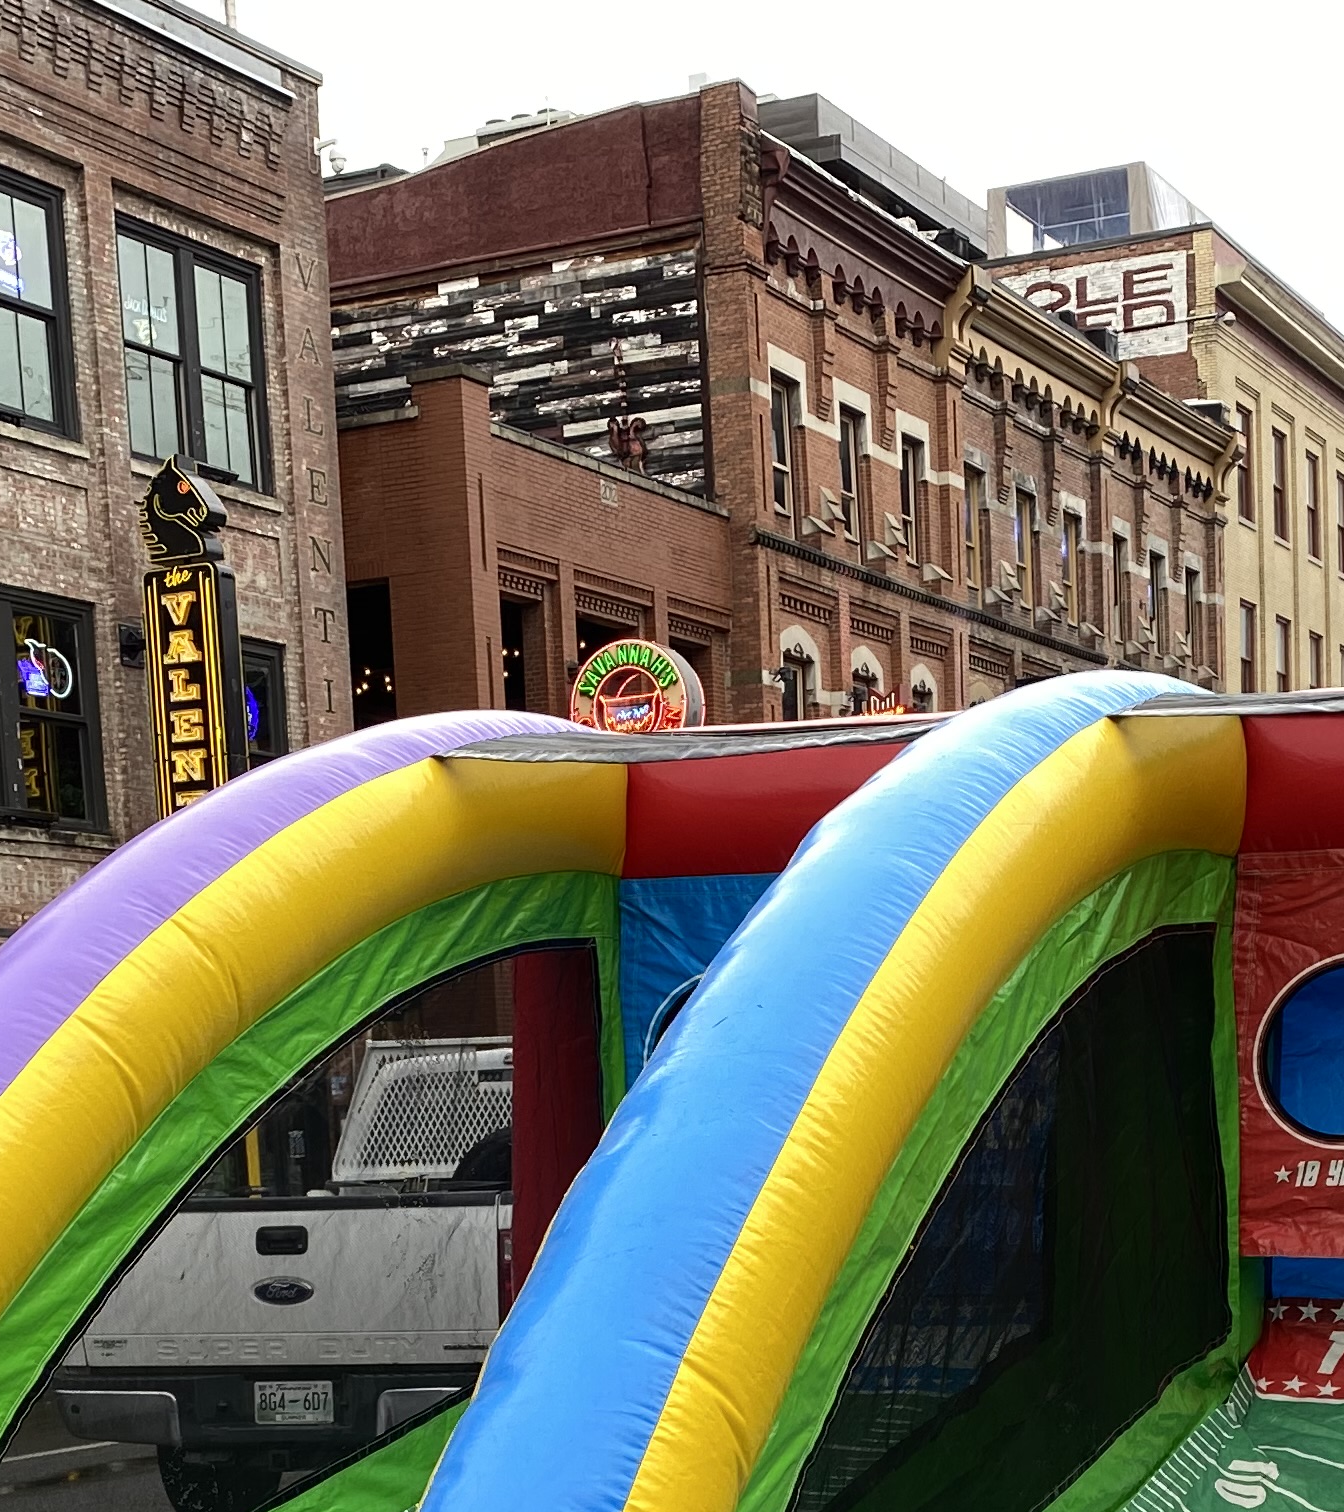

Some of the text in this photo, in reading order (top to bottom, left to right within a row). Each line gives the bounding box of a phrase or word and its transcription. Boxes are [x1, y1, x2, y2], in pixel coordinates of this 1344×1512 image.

[163, 567, 192, 588] the
[577, 643, 678, 699] SAVANNAH'S
[1295, 1160, 1321, 1187] 10
[266, 1280, 299, 1300] Ford
[156, 1337, 423, 1361] SUPER DUTY
[1214, 1459, 1280, 1509] 10
